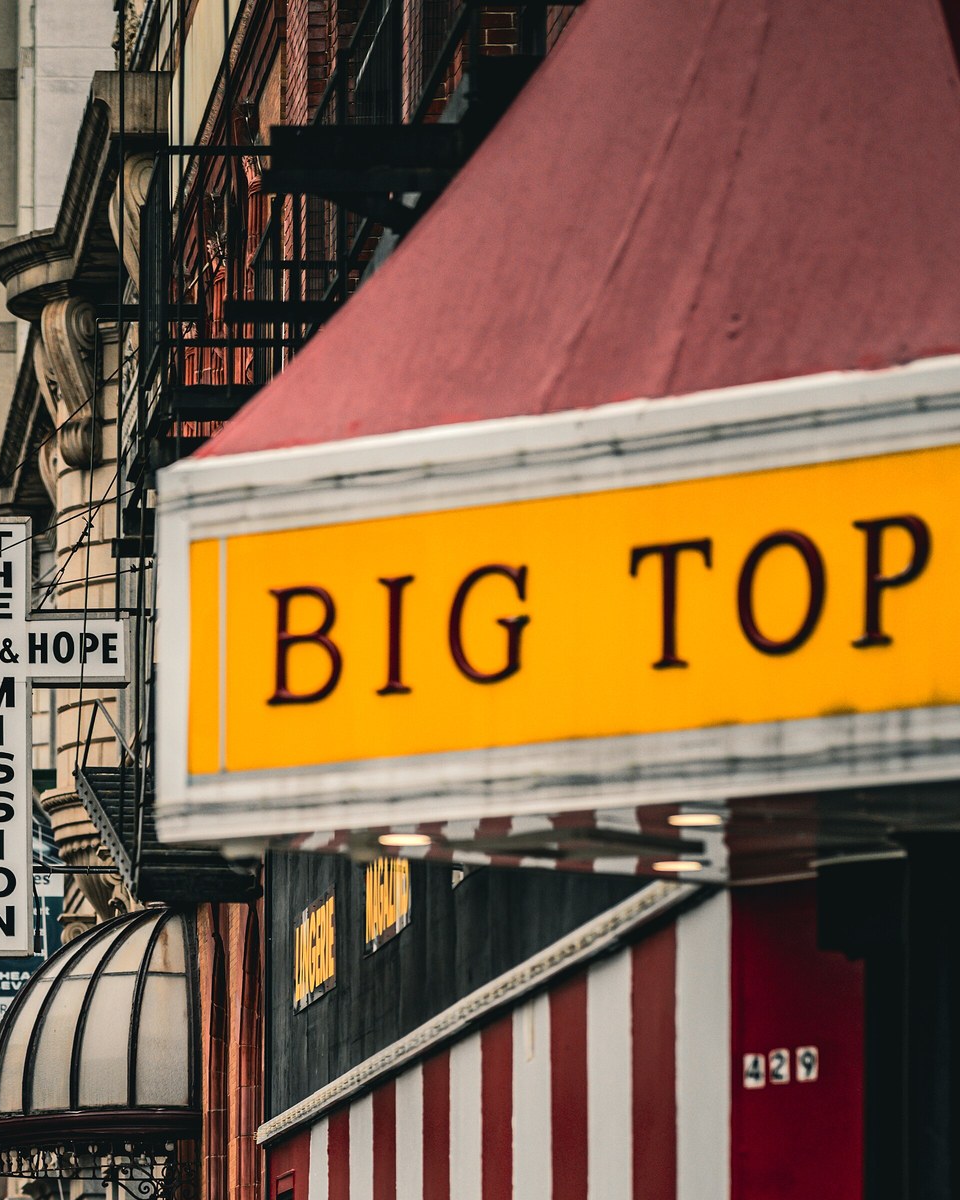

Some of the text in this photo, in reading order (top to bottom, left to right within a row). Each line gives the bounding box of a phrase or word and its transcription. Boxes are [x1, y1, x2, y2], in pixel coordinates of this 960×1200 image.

[266, 512, 933, 708] BIG TOP
[0, 637, 19, 664] &
[28, 631, 118, 664] HOPE
[295, 896, 335, 1003] LINGERIE
[745, 1050, 816, 1082] 429
